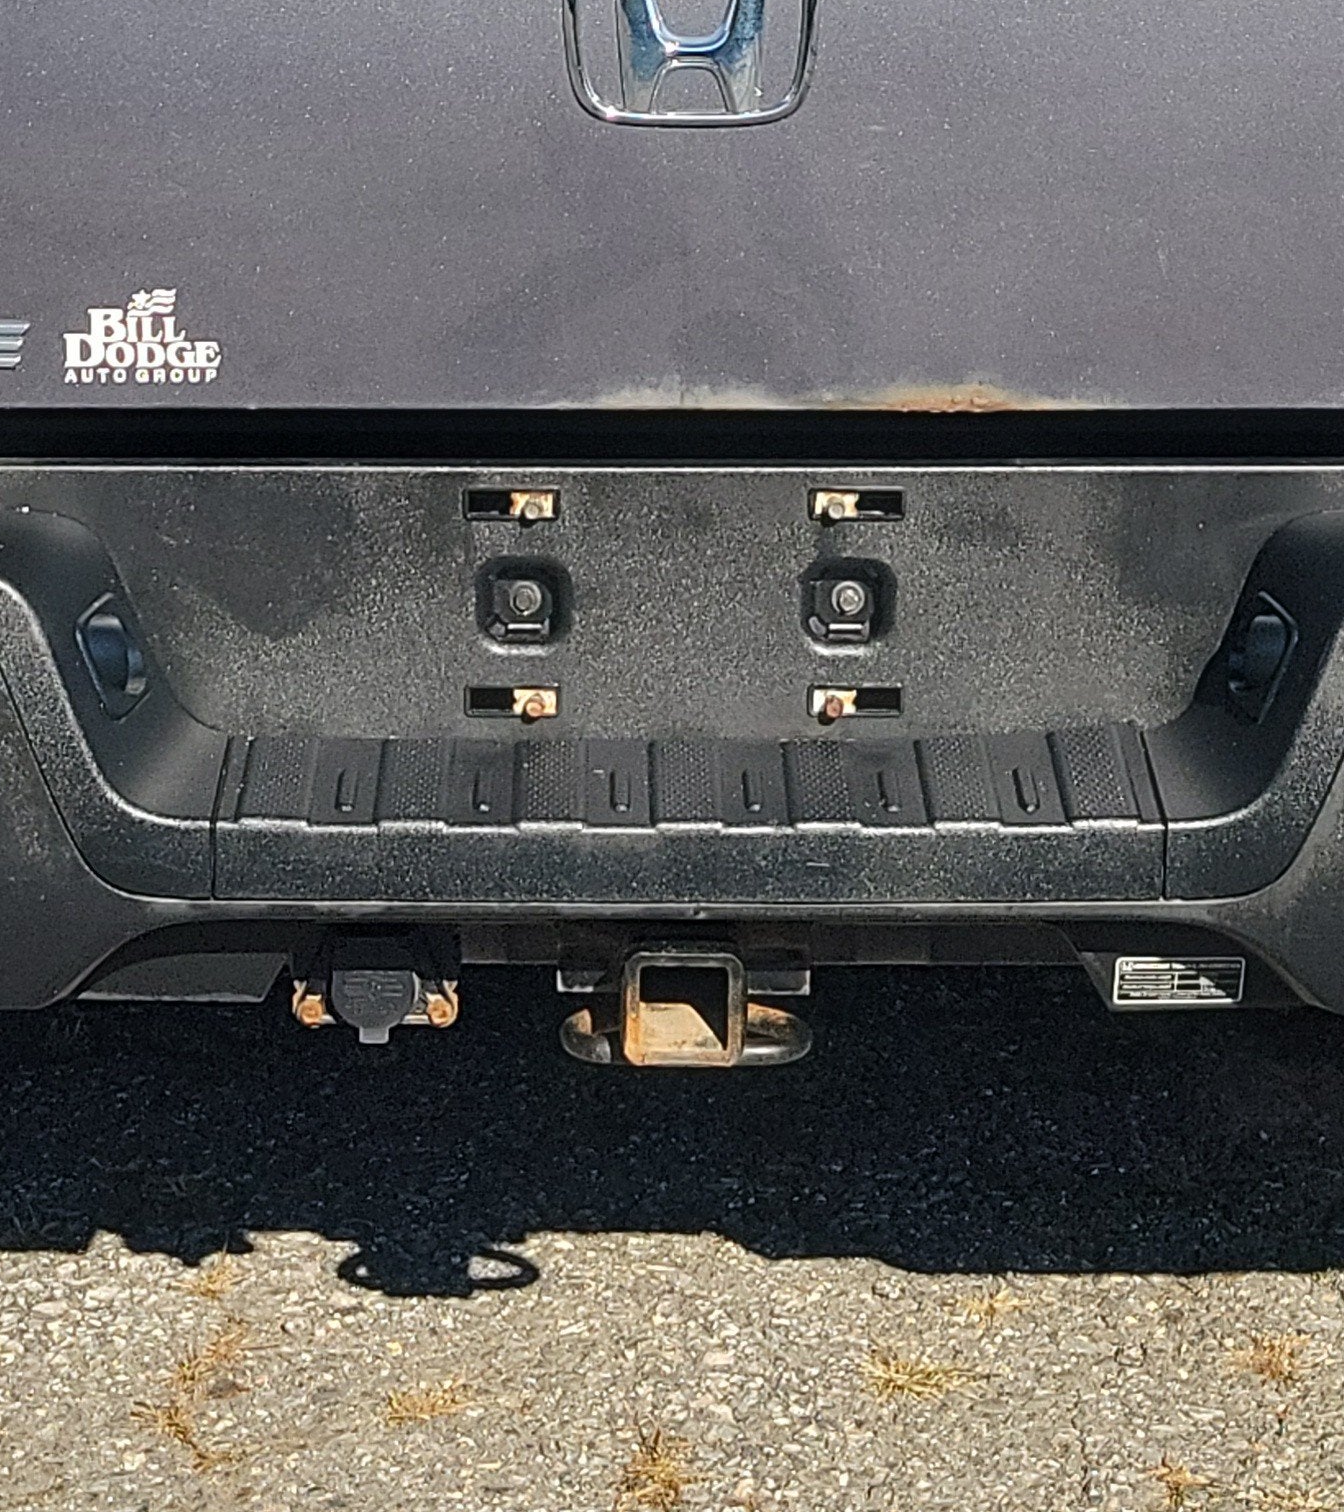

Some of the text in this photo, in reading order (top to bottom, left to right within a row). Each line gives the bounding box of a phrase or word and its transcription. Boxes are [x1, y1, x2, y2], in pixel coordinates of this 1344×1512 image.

[87, 308, 186, 343] BILL
[63, 333, 222, 369] DODGE
[64, 368, 218, 384] AUTO GROUP
